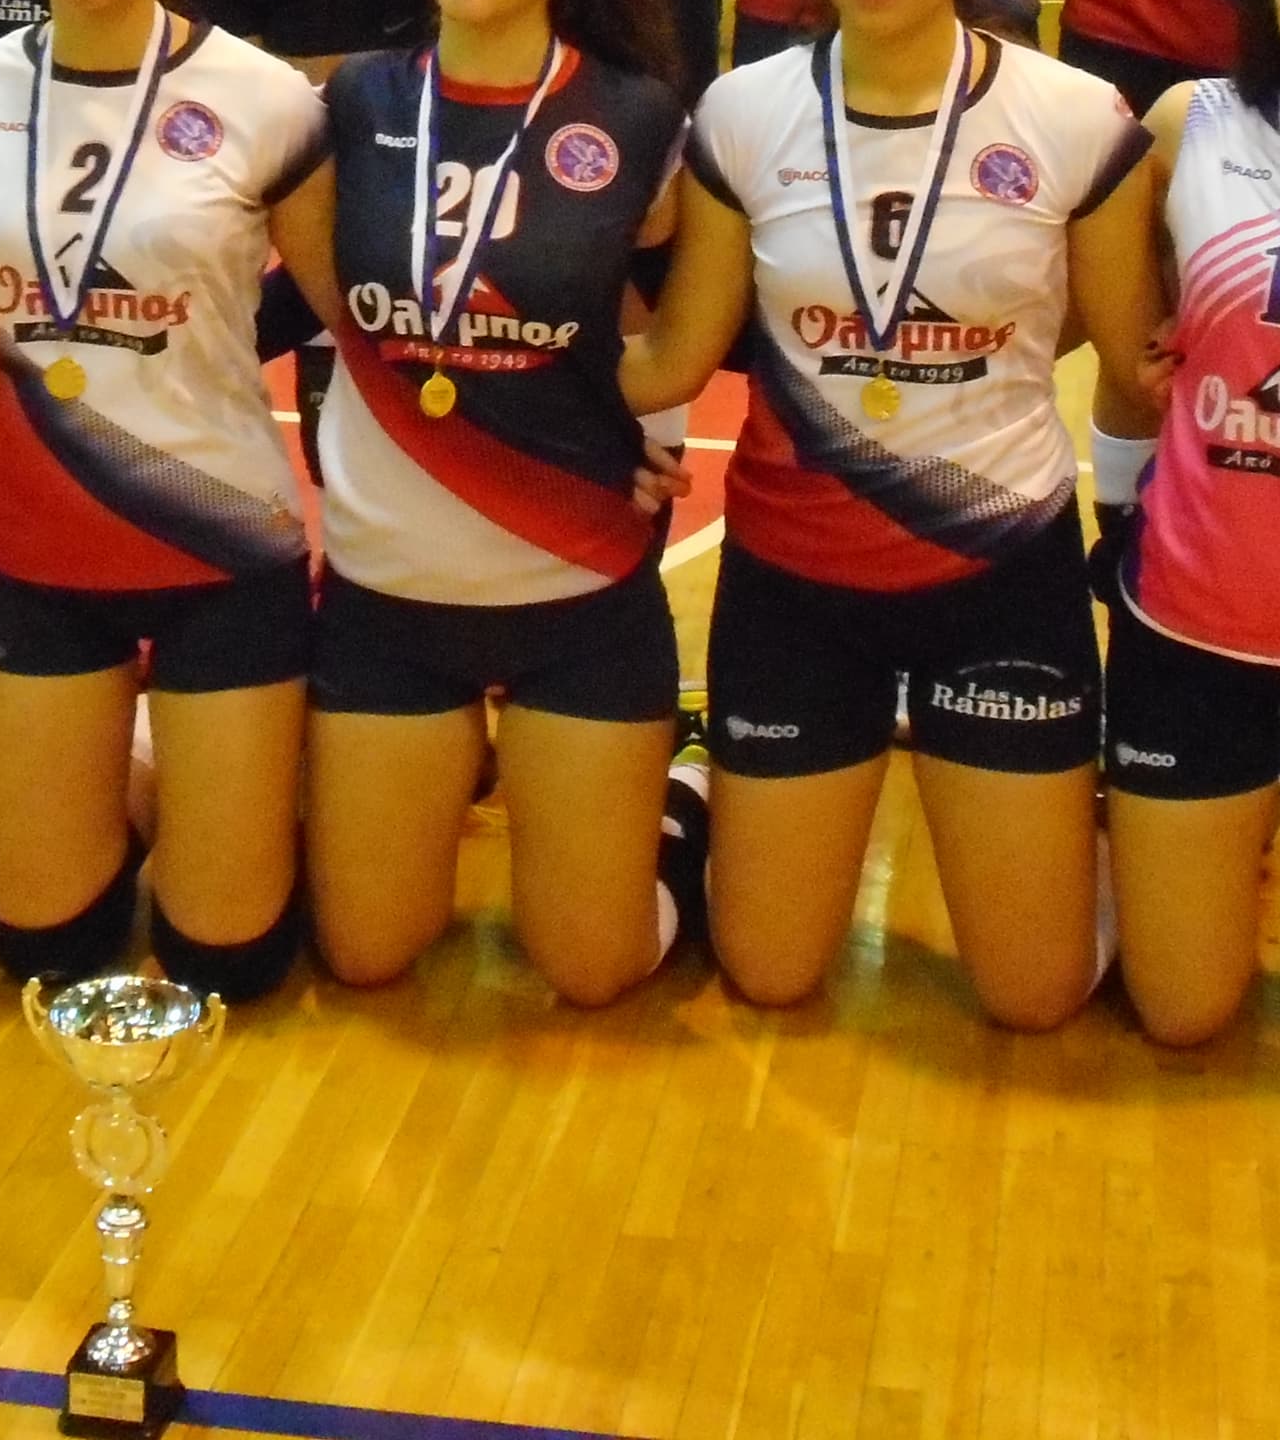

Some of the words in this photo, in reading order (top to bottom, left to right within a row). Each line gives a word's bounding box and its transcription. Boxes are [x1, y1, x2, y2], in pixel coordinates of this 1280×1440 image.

[61, 142, 113, 213] 2
[872, 191, 915, 260] 6
[480, 353, 527, 368] 1949
[919, 367, 964, 383] 1949
[932, 683, 1082, 722] Ramblas
[968, 682, 1010, 702] Las
